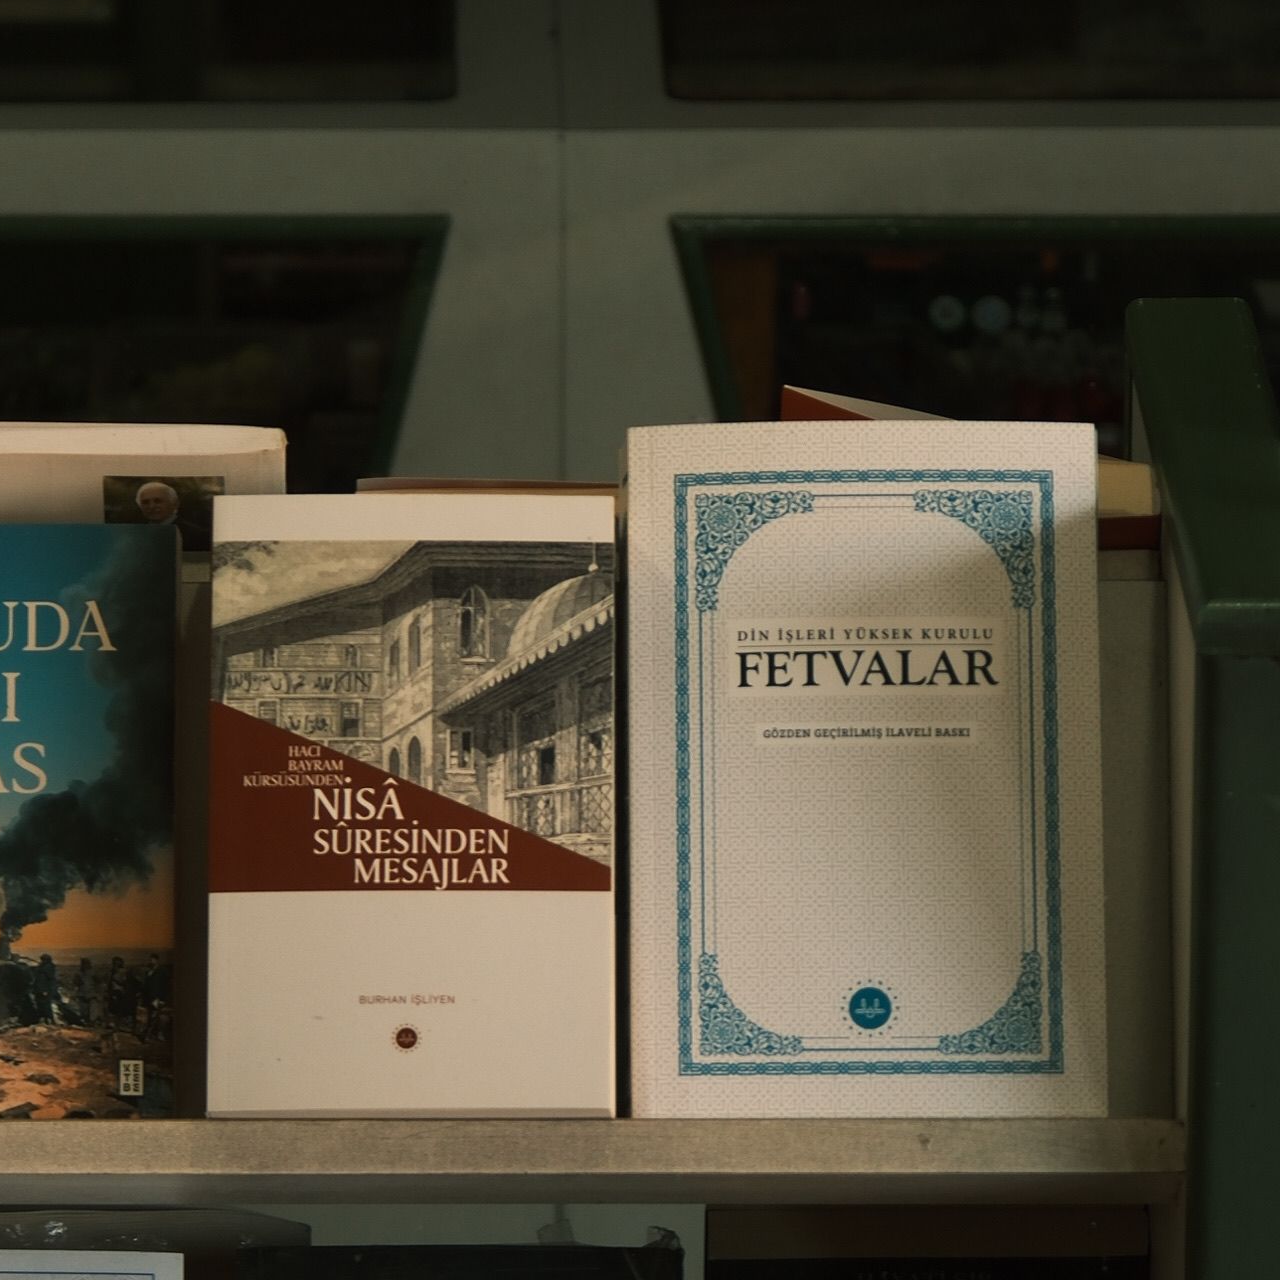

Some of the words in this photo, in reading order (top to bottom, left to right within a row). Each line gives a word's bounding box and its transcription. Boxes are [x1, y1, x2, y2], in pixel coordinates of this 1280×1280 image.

[737, 628, 769, 641] DİN
[778, 628, 835, 643] İŞLERİ
[844, 628, 913, 640] YÜKSEK
[922, 628, 993, 640] KURULU
[736, 650, 999, 687] FETVALAR
[763, 727, 810, 738] GÖZDEN
[814, 727, 883, 740] GEÇİRİLMİŞ
[935, 727, 971, 737] BASKI
[288, 745, 321, 758] HACI
[288, 759, 343, 771] BAYRAM
[243, 771, 344, 787] KÜRSÜSÜNDEN
[313, 776, 405, 821] NİSÂ
[313, 820, 509, 855] SÛRESİNDEN
[353, 858, 510, 890] MESAJLAR
[358, 995, 407, 1004] BURHAN
